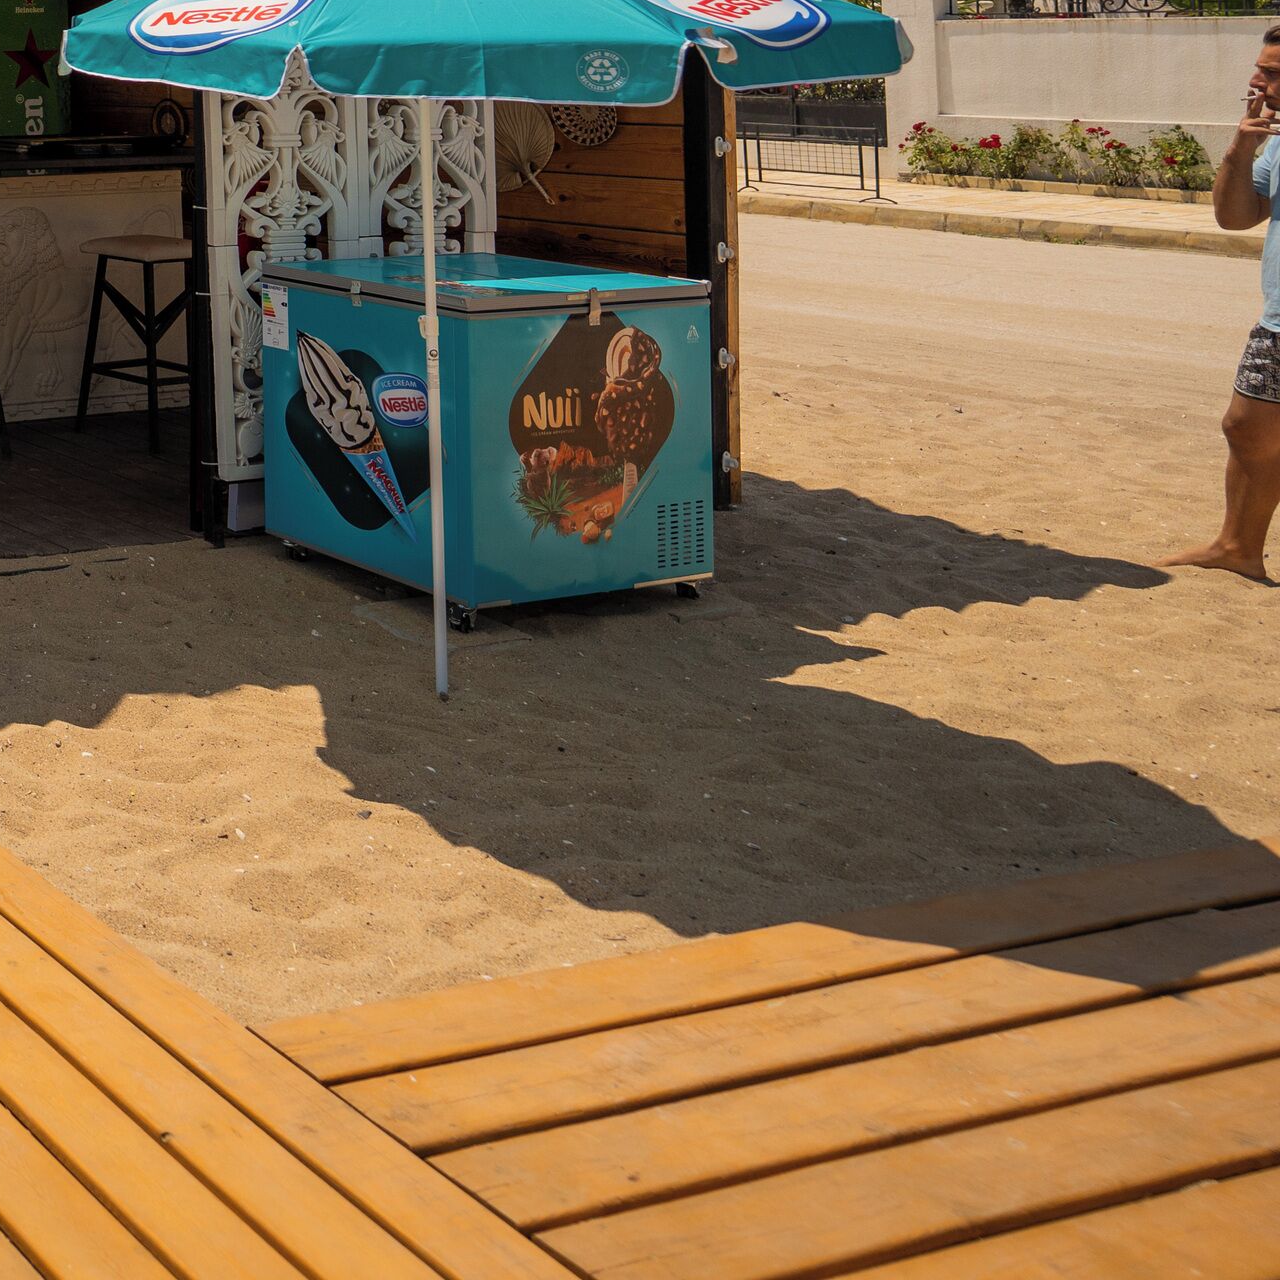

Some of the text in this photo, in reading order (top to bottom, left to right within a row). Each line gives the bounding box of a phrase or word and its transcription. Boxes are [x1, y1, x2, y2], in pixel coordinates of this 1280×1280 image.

[15, 6, 45, 14] Heineken
[149, 2, 289, 27] Nestlé
[392, 379, 417, 388] CREAM
[381, 396, 426, 413] Nestlé
